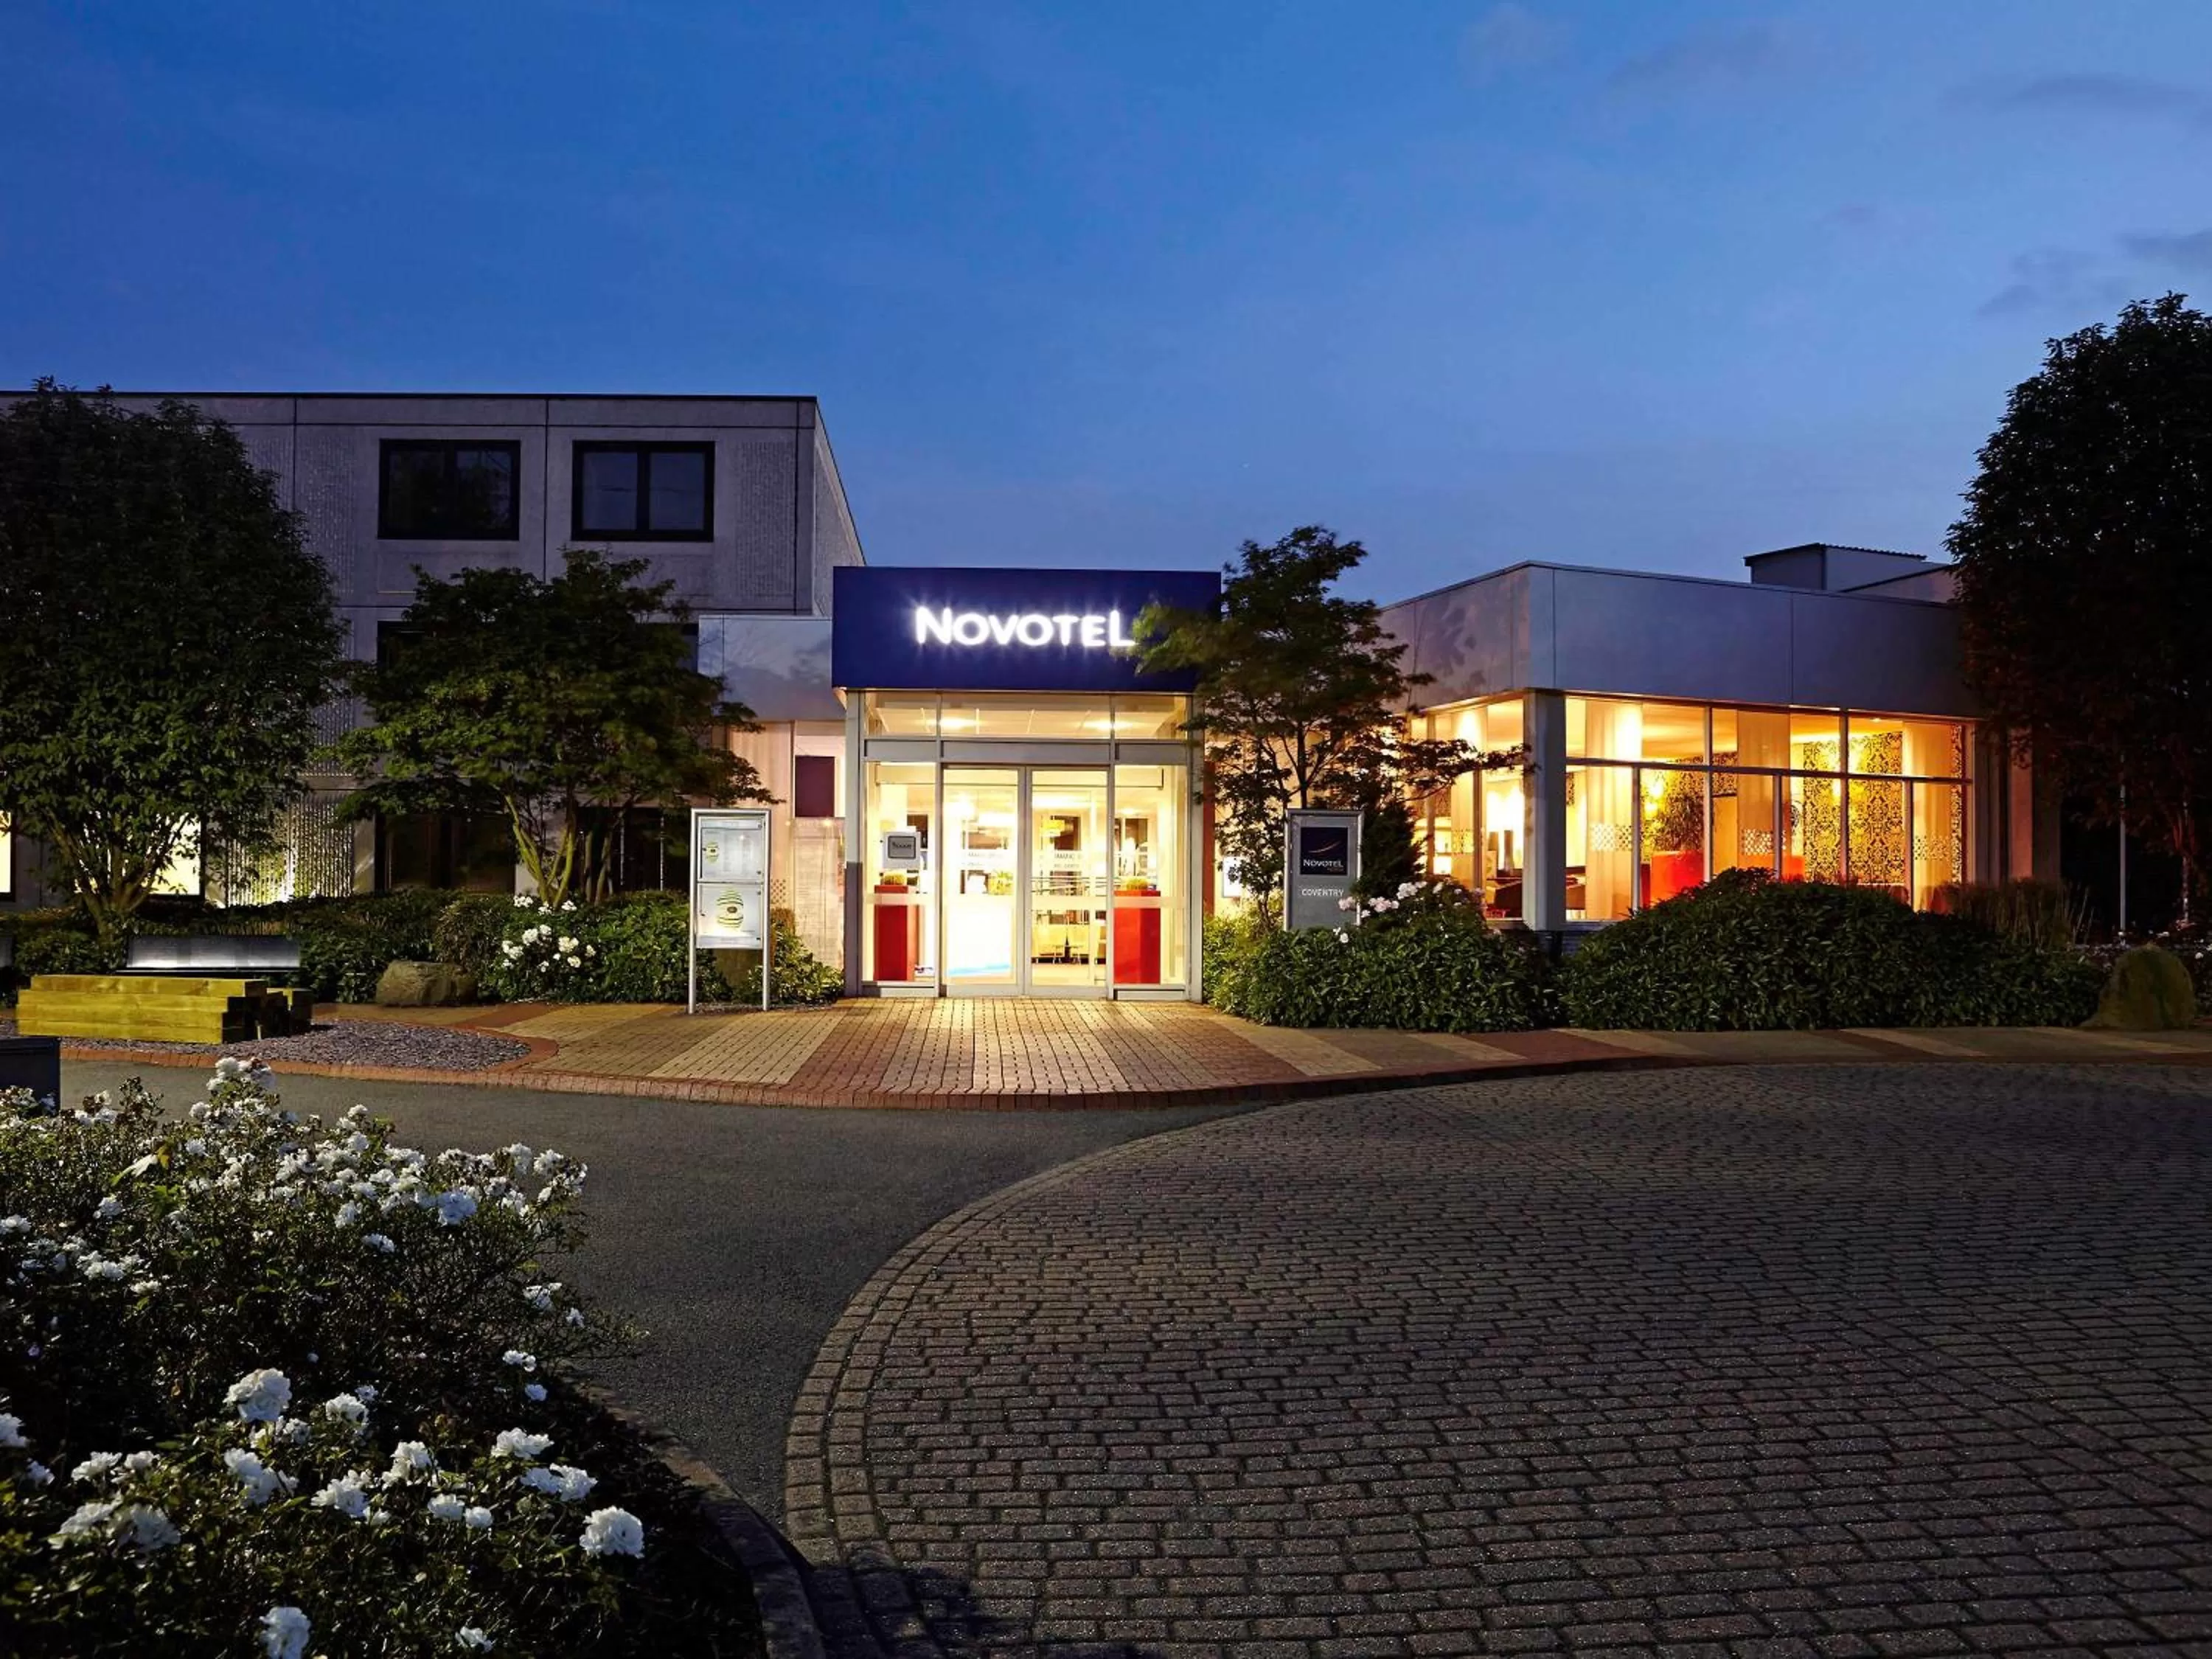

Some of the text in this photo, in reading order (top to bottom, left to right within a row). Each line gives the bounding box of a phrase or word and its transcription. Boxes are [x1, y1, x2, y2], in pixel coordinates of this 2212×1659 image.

[915, 605, 1136, 647] NOVOTEL
[1303, 859, 1343, 868] NOVOTEL
[1301, 888, 1344, 897] COVENTRY
